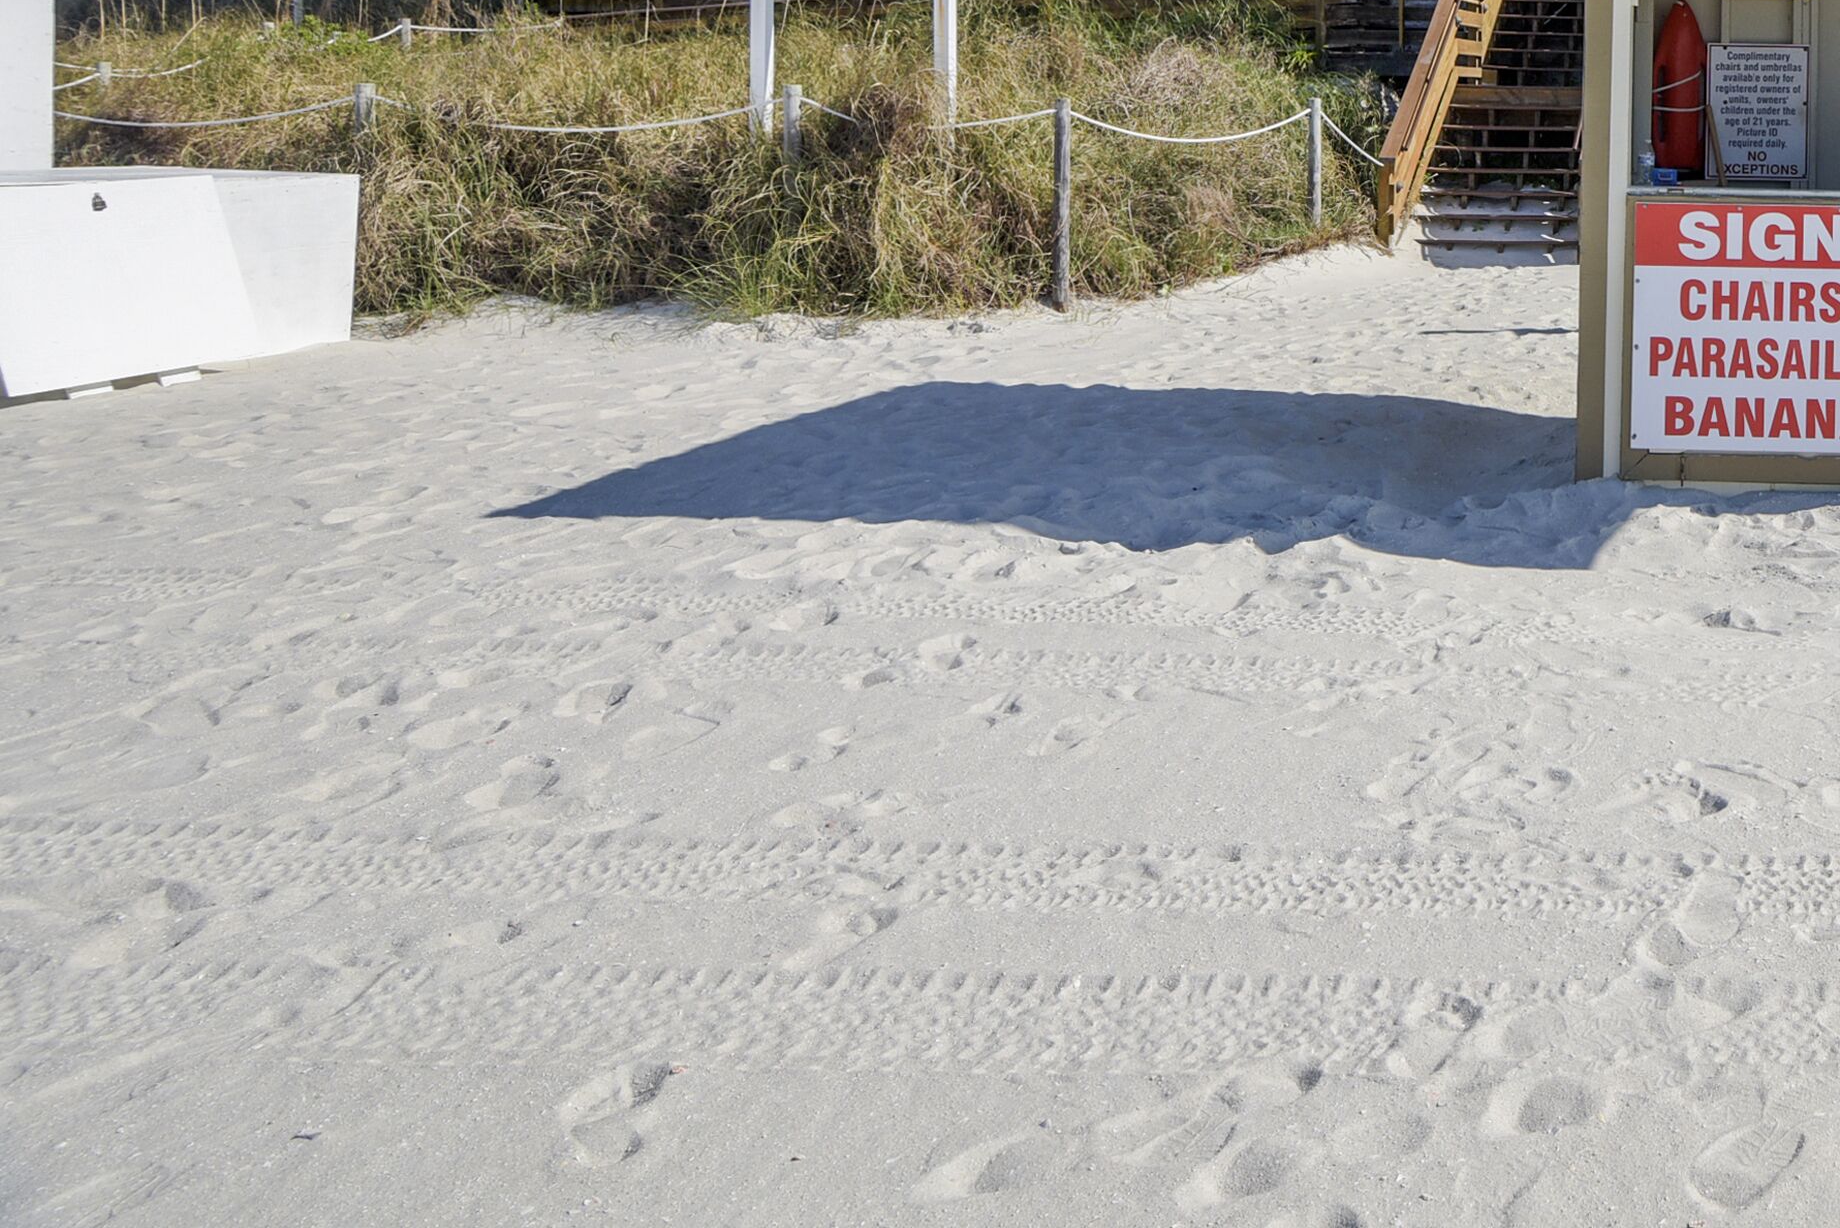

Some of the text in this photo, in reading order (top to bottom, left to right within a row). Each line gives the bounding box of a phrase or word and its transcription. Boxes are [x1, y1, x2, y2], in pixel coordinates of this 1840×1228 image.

[1727, 52, 1790, 62] Complimentary
[1715, 63, 1802, 72] chairs and umbrellas
[1763, 74, 1780, 84] only
[1783, 74, 1794, 82] for
[1715, 84, 1757, 94] registered
[1793, 85, 1801, 93] of
[1729, 96, 1751, 104] units,
[1721, 106, 1796, 115] children under the
[1725, 117, 1791, 127] age of 21 years.
[1737, 128, 1778, 137] Picture ID
[1728, 139, 1787, 149] required daily.
[1748, 151, 1767, 161] NO
[1722, 164, 1798, 175] XCEPTIONS
